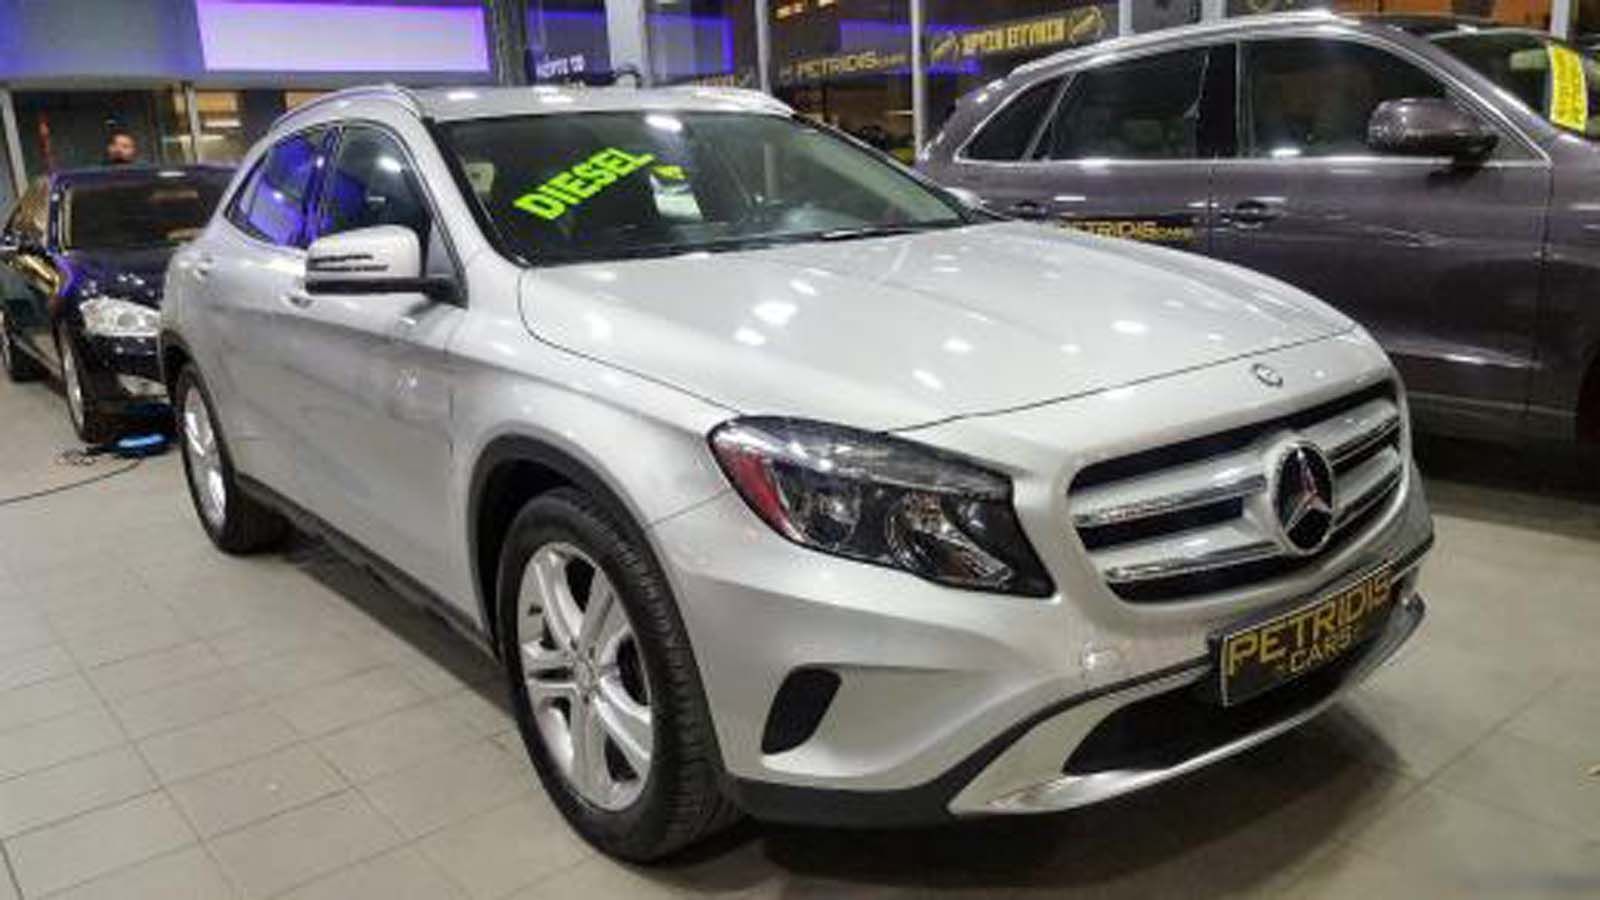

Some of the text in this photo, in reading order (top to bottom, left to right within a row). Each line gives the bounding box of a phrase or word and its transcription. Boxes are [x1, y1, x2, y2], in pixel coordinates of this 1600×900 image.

[513, 147, 655, 221] DIESEL
[1228, 572, 1392, 677] PETRIDIS
[1289, 625, 1353, 674] CARS
